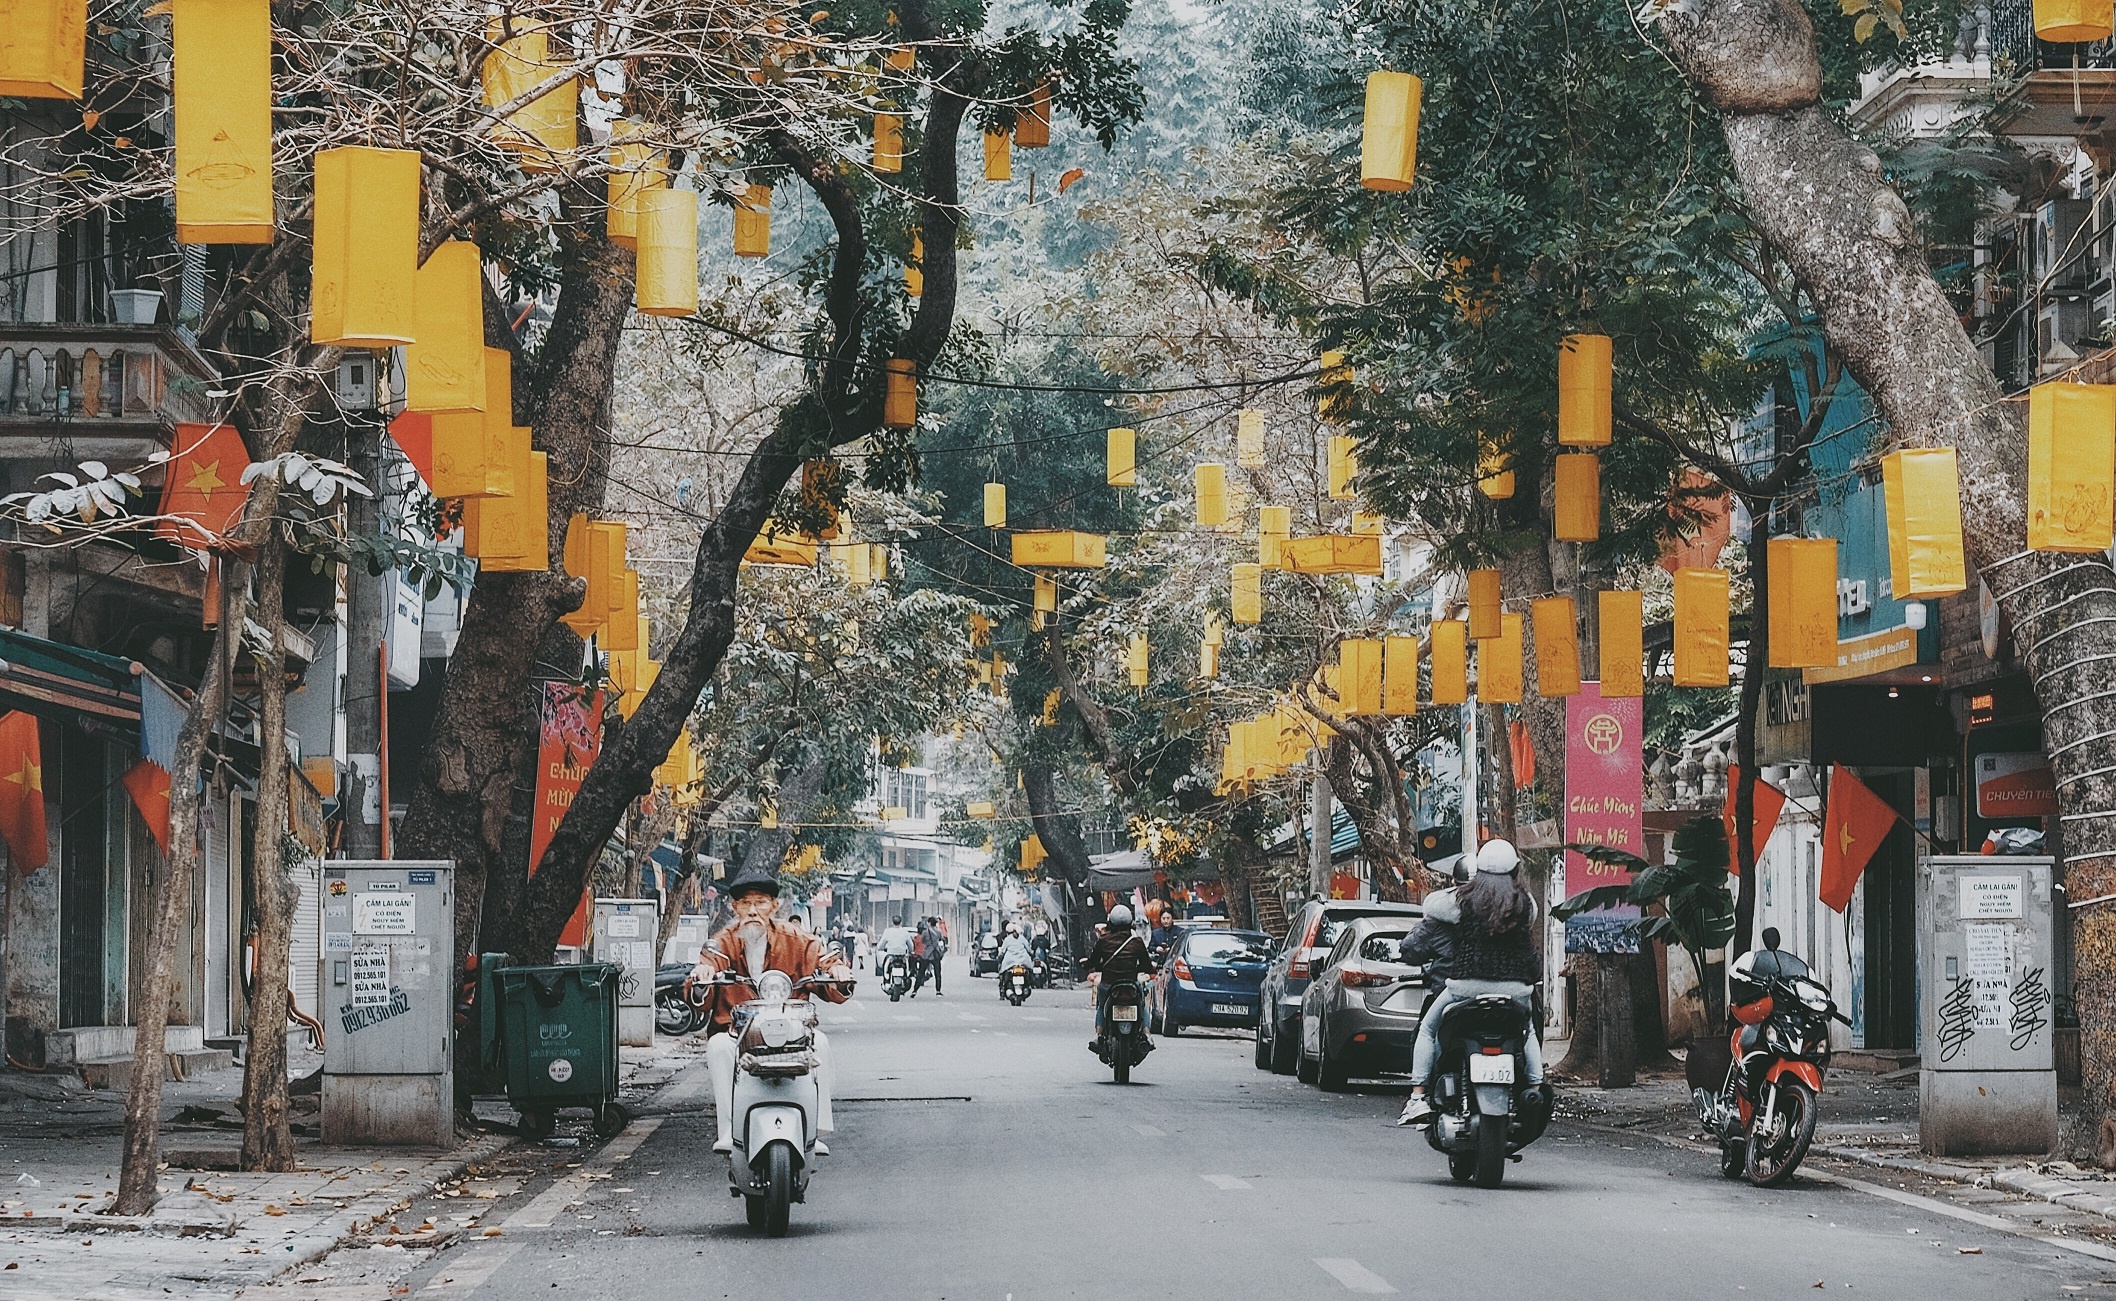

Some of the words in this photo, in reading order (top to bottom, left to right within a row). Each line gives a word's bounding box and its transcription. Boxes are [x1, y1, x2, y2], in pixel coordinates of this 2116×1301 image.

[1570, 795, 1600, 815] Chúc
[1576, 827, 1603, 845] Năm
[353, 957, 368, 967] SỬA
[370, 957, 386, 967] NHÀ
[354, 981, 369, 991] SỬA
[371, 981, 387, 991] NHÀ
